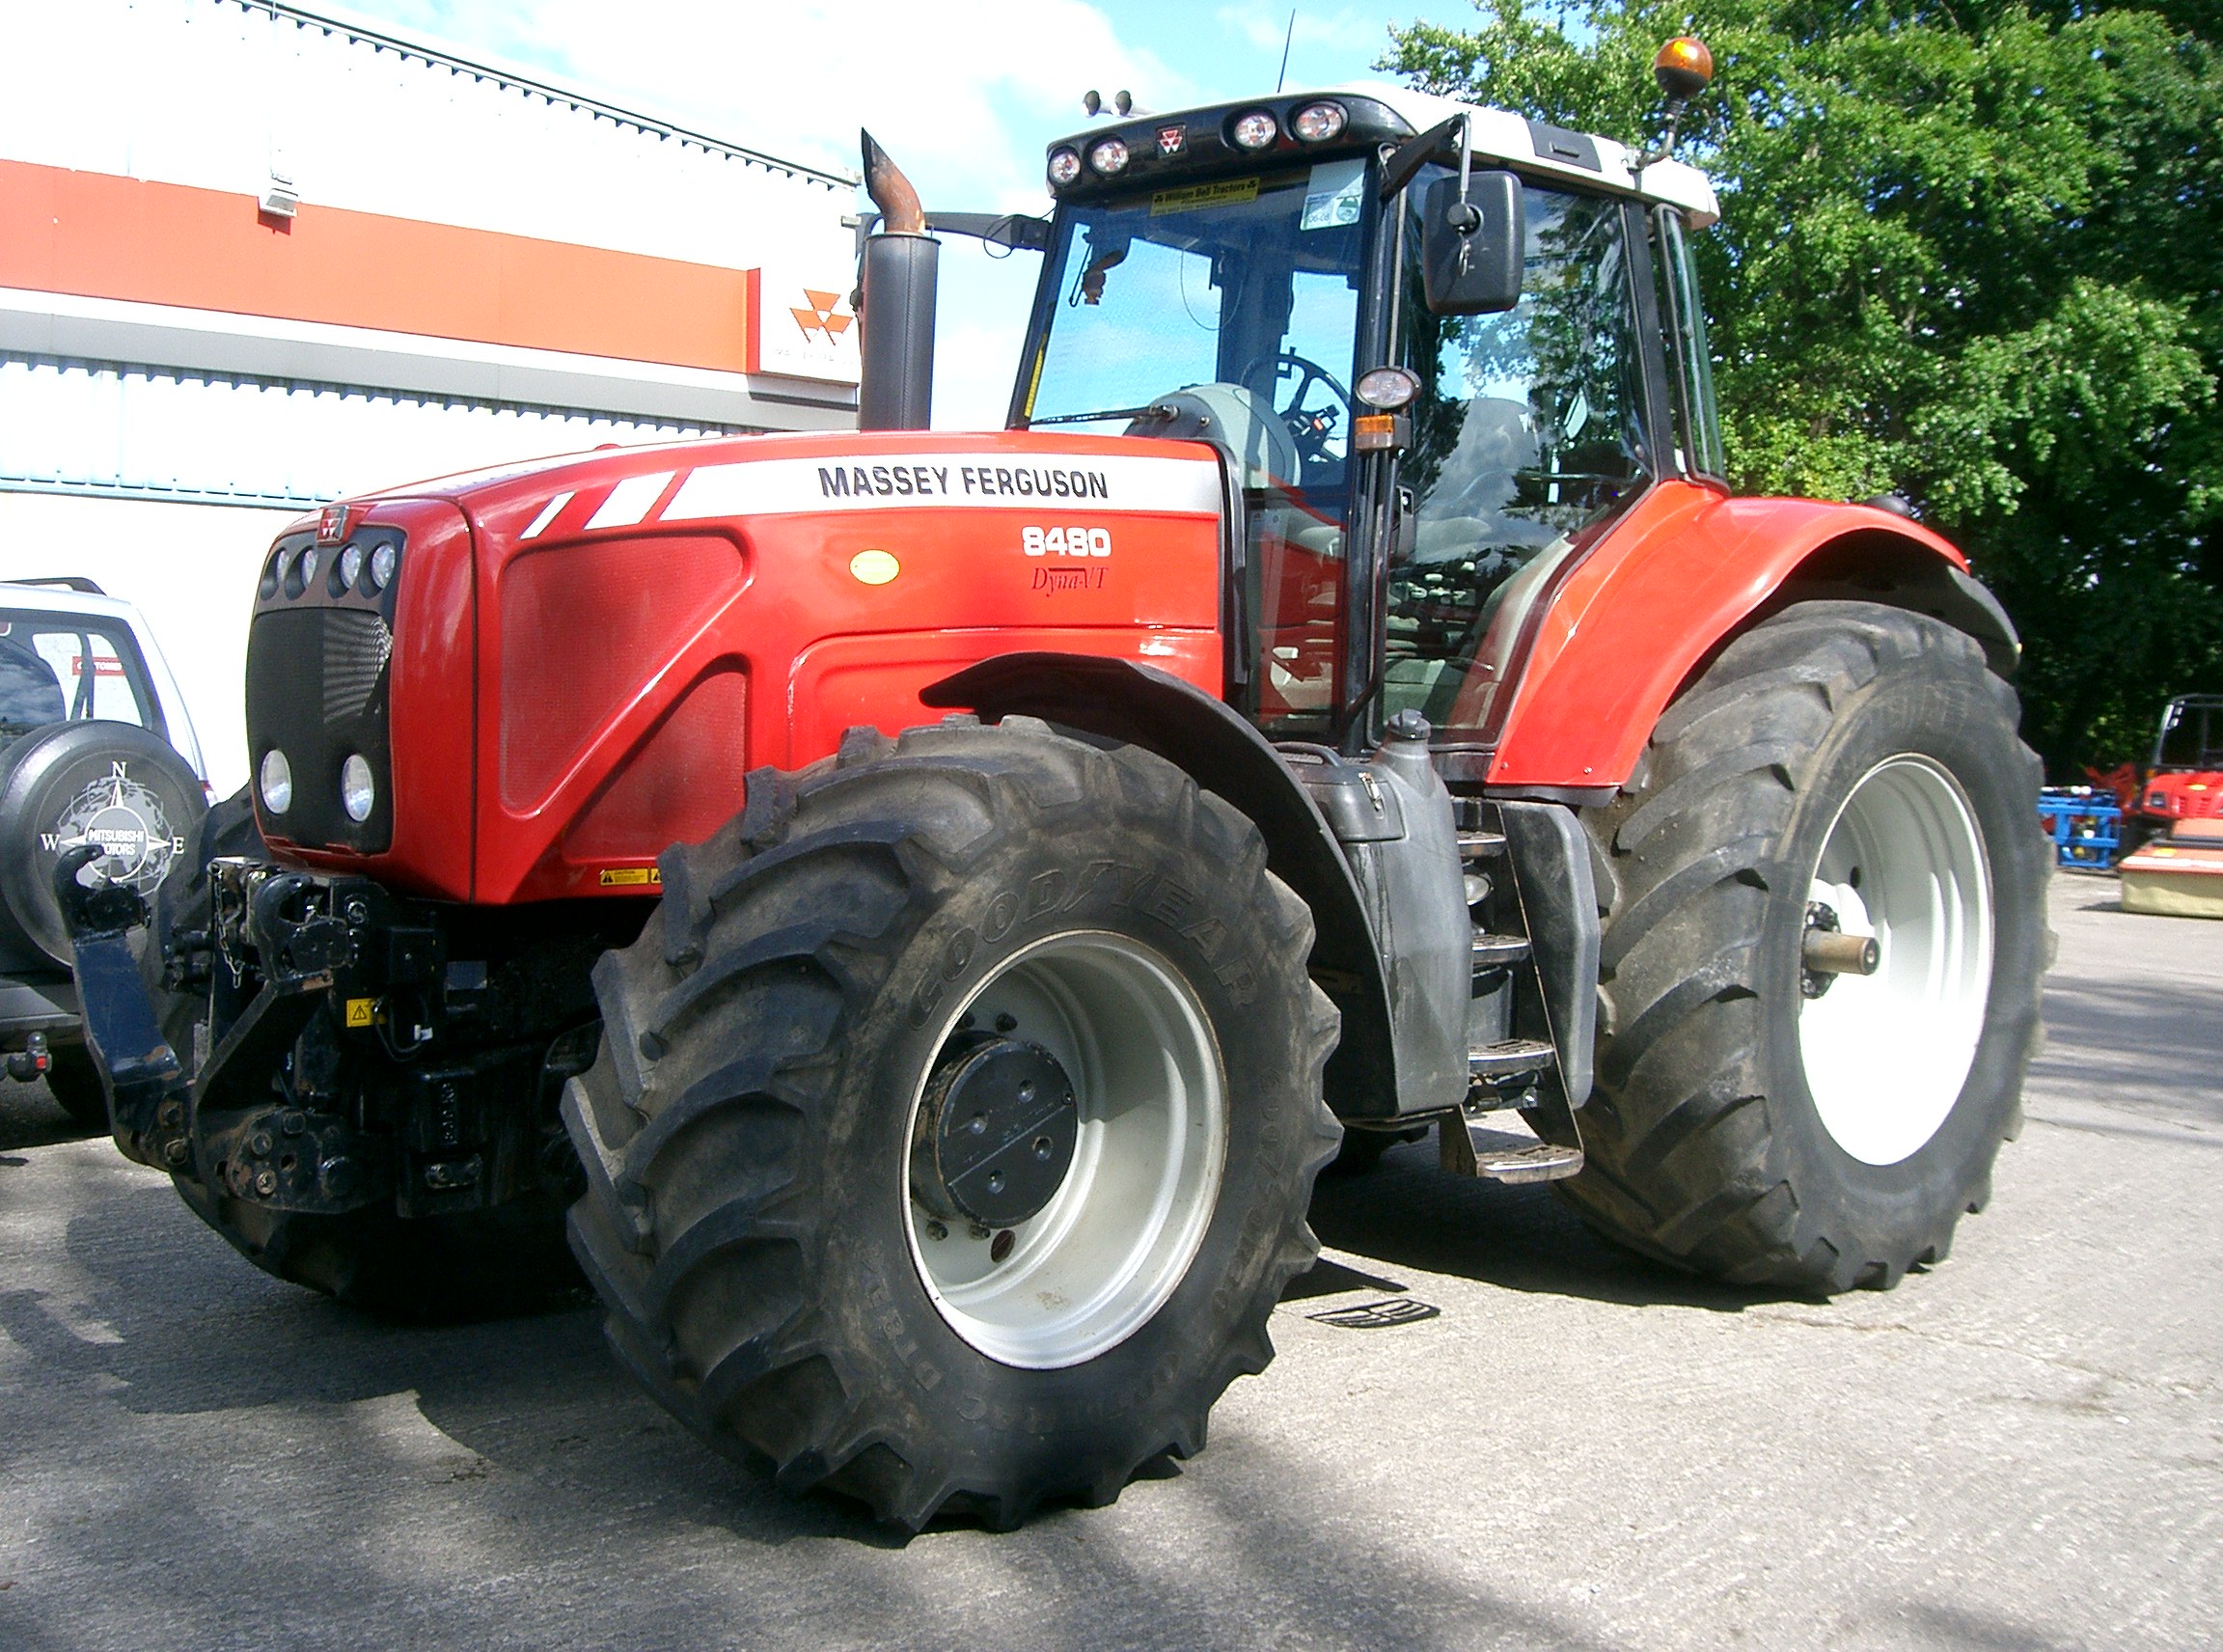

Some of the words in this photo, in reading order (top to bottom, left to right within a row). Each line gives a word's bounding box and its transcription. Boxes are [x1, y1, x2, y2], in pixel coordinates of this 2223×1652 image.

[818, 467, 947, 498] MASSEY
[961, 467, 1110, 499] FERGUSON
[1021, 526, 1112, 558] 8480
[112, 761, 127, 779] N
[41, 833, 61, 851] W
[173, 837, 184, 855] E
[88, 829, 144, 842] MITSUBISHI
[101, 842, 136, 856] OTORS
[910, 860, 1255, 1031] GOODYEAR
